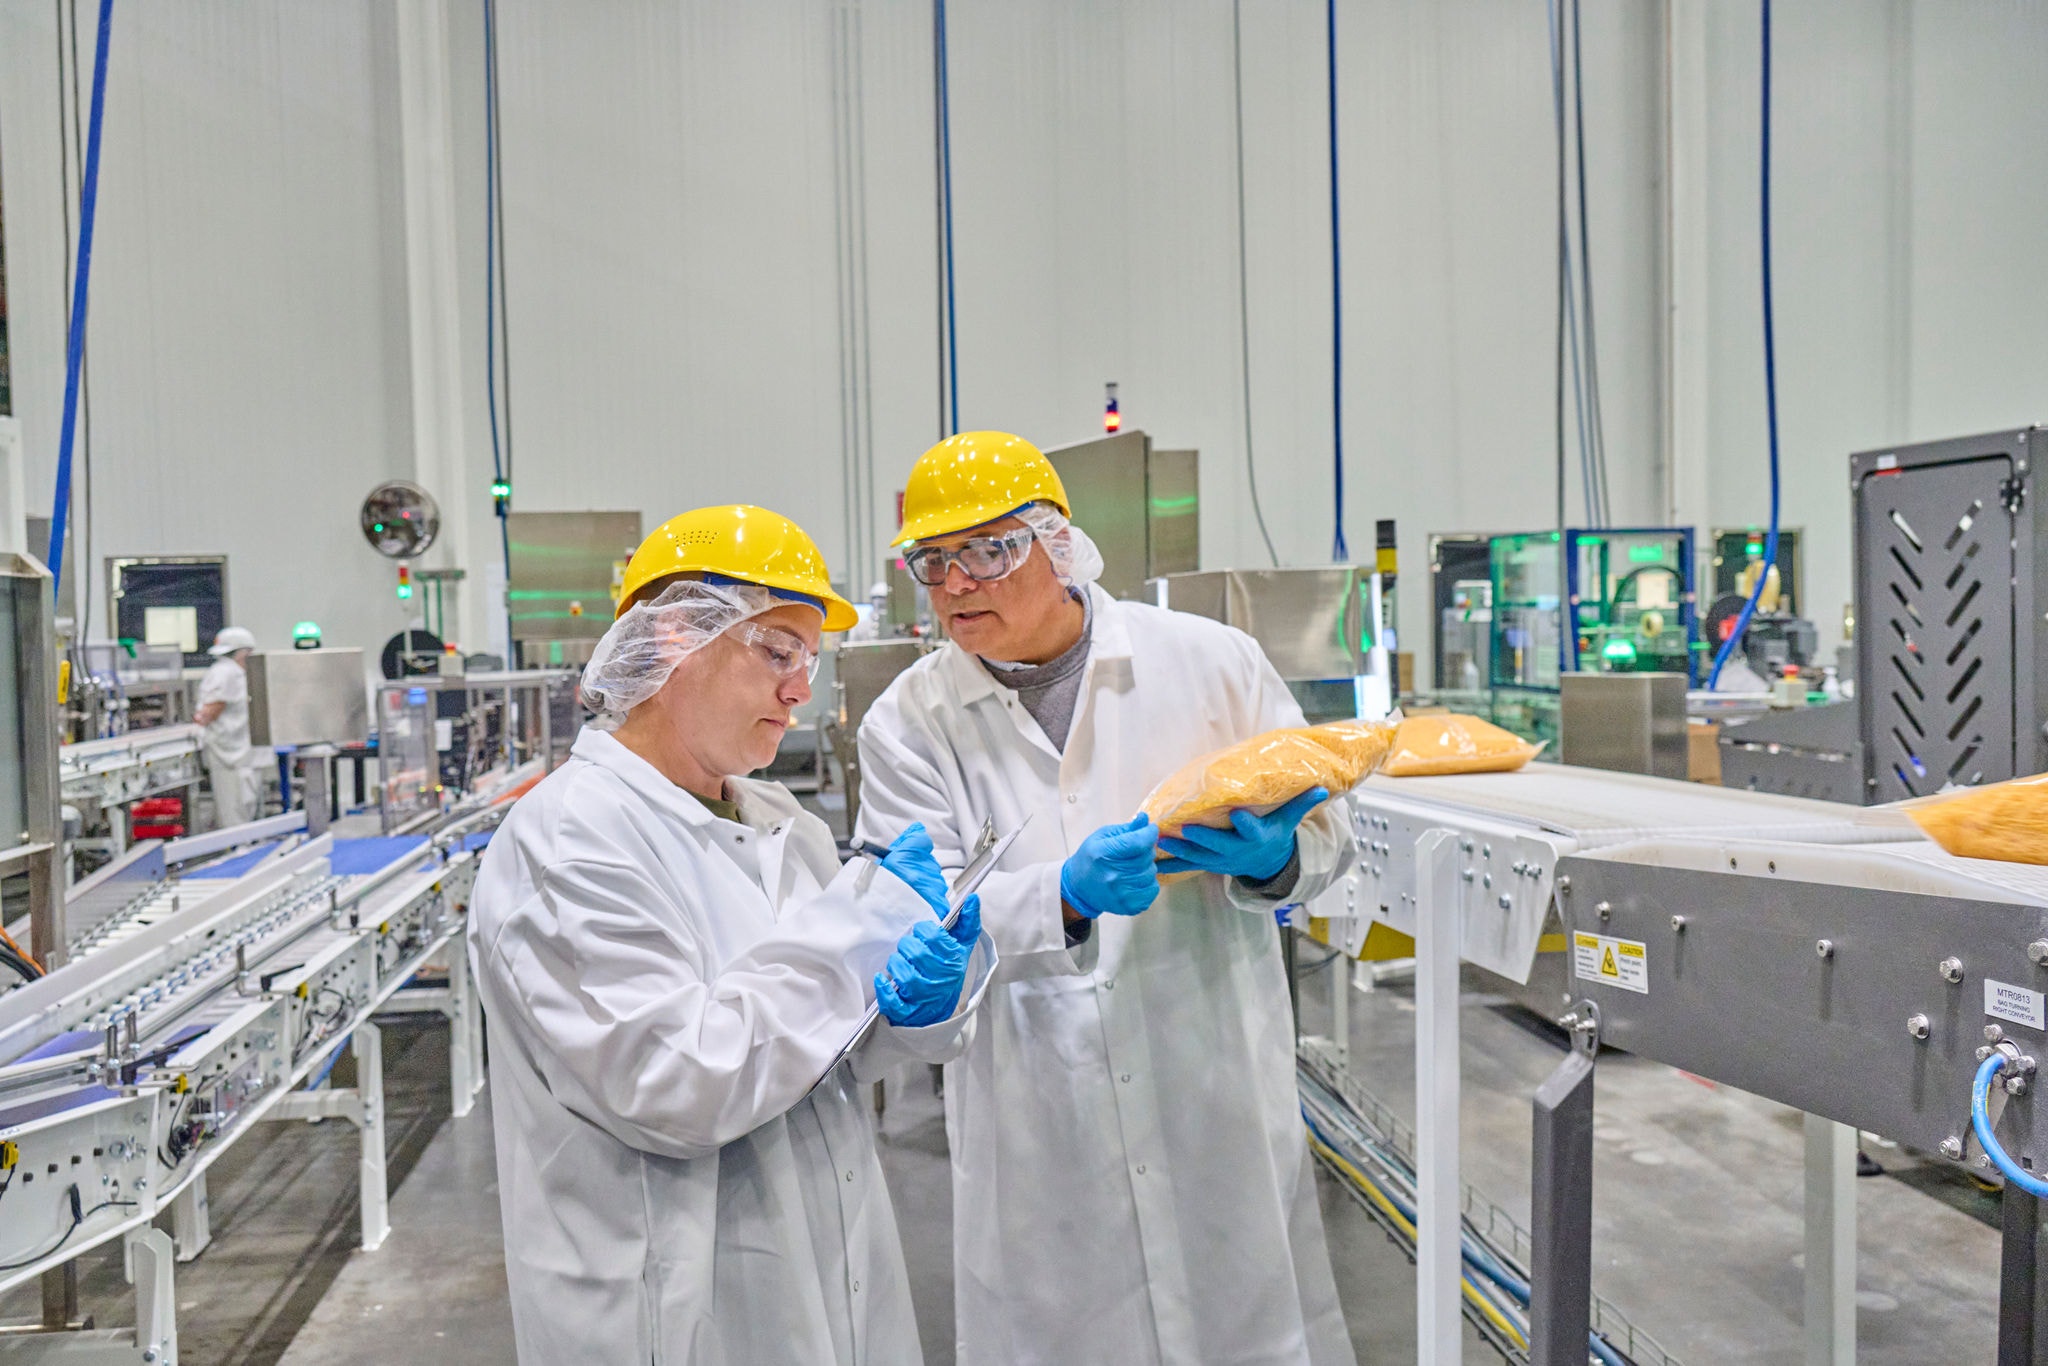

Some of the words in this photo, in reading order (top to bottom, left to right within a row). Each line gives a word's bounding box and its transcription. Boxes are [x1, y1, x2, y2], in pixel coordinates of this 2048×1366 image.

[1624, 945, 1643, 956] CAUTION
[1997, 987, 2031, 1004] MTR0813
[1992, 1005, 2007, 1014] RIGHT
[2008, 1009, 2036, 1022] CONVEYOR
